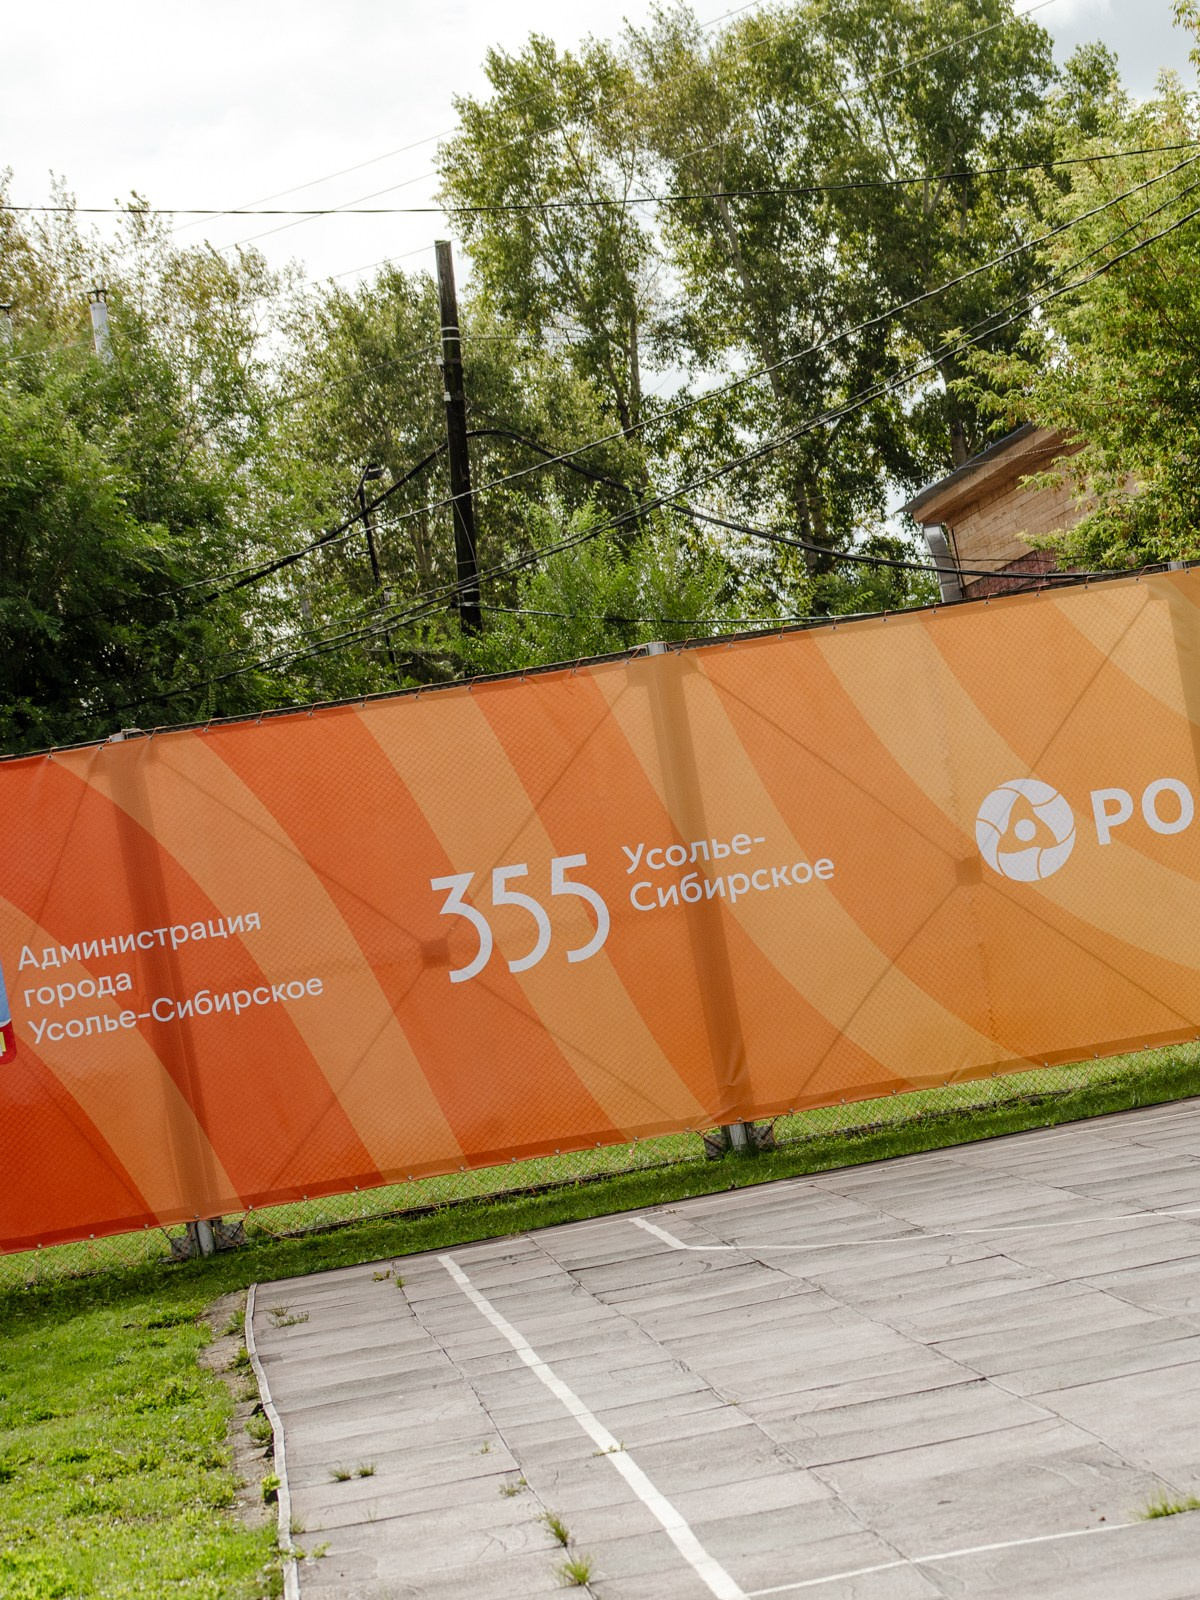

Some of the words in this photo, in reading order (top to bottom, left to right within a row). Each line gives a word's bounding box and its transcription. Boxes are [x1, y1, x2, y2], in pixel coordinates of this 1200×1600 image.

[621, 832, 766, 874] Усолье-
[629, 857, 836, 912] Сибирское
[18, 911, 262, 971] Администрация
[430, 853, 610, 984] 355
[24, 972, 133, 1008] города
[28, 977, 324, 1045] Усолье-Сибирское
